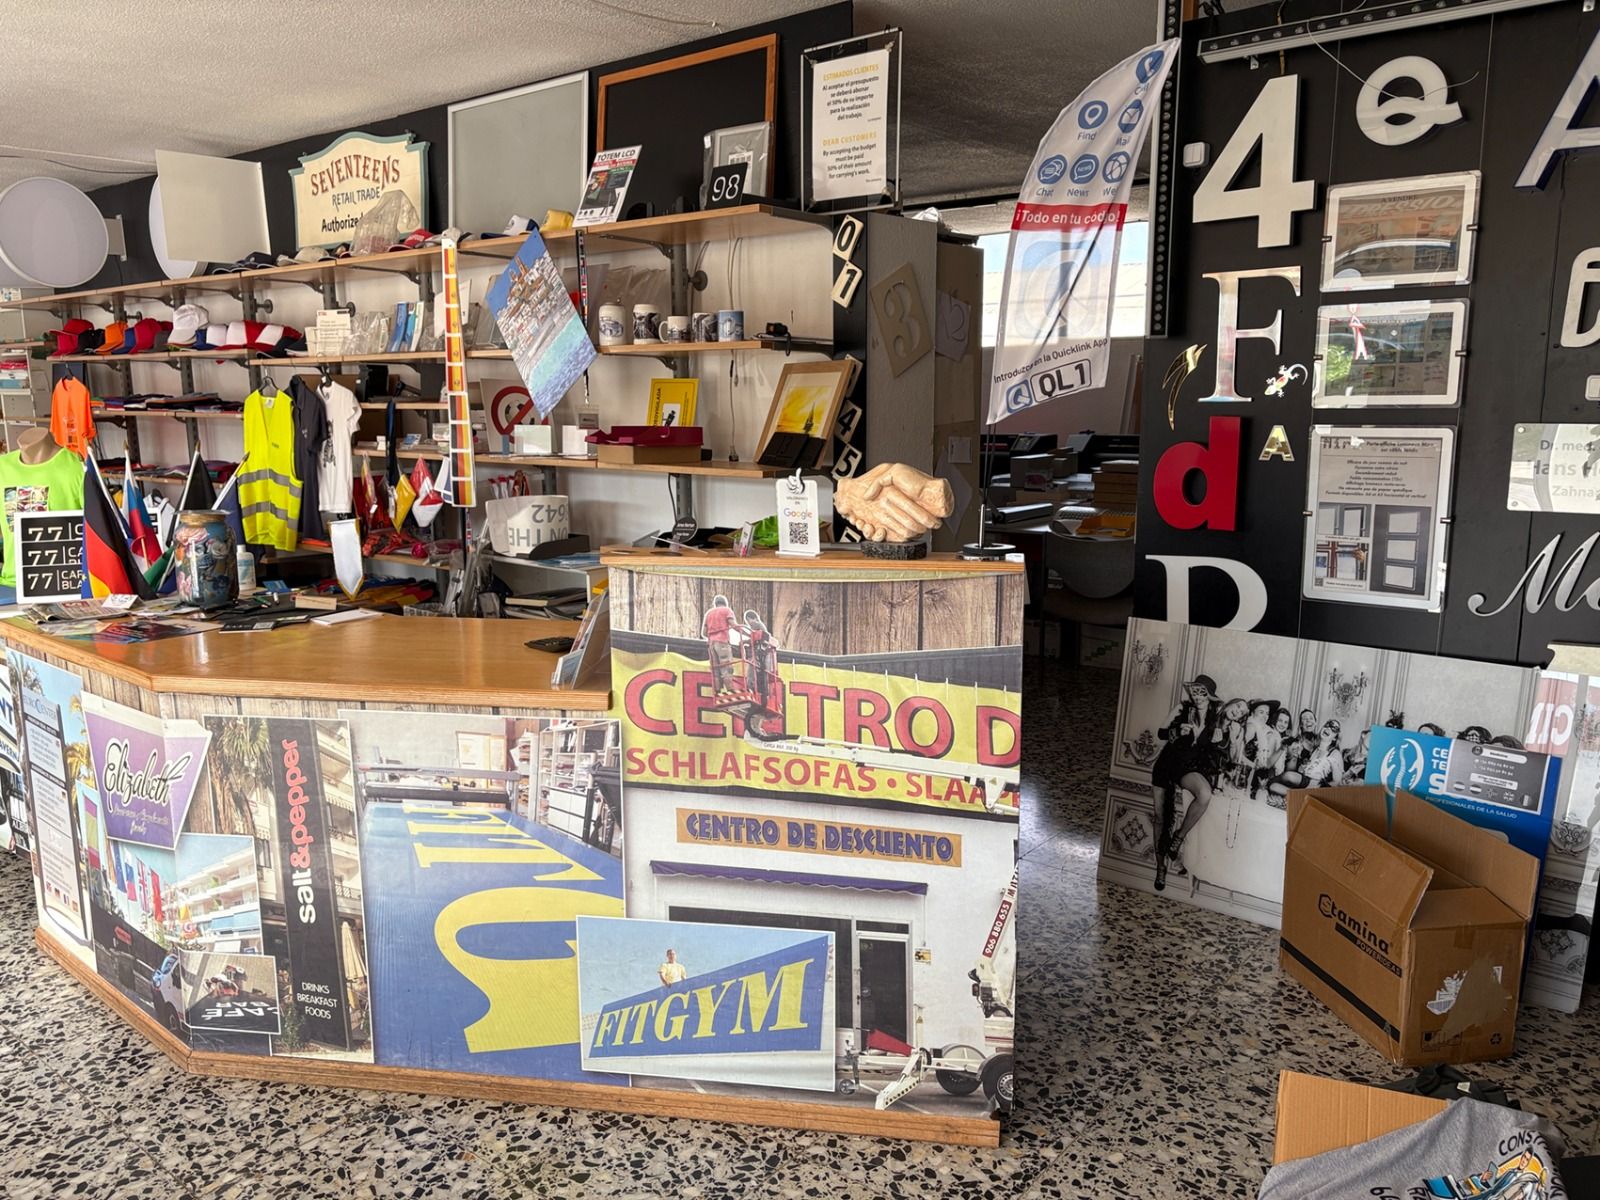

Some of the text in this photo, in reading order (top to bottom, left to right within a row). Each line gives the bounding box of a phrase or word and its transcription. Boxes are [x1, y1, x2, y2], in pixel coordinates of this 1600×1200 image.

[1077, 131, 1097, 141] Find
[597, 149, 636, 161] TOTEM LCD
[1192, 75, 1316, 249] 4
[310, 154, 401, 196] SEVENTEENS
[711, 173, 740, 202] 98
[331, 186, 381, 213] RETAIL TRADE
[1035, 187, 1055, 197] Chat
[1066, 188, 1090, 198] News
[1052, 212, 1067, 225] en
[1070, 211, 1081, 225] tu
[839, 268, 858, 300] 1
[1198, 266, 1302, 402] F
[1043, 353, 1052, 363] la
[1052, 342, 1093, 360] Quicklink
[1092, 338, 1109, 349] App
[837, 407, 858, 437] 4
[1258, 424, 1295, 462] A
[1562, 441, 1596, 452] med.
[834, 448, 859, 478] 5
[1153, 415, 1242, 532] d
[783, 507, 813, 521] Google
[27, 573, 54, 591] 77
[104, 741, 191, 811] Elizabeth
[625, 746, 877, 793] SCHLAFSOFAS
[1495, 808, 1518, 820] SALUD
[686, 812, 954, 863] CENTRO DE DESCUENTO
[984, 938, 996, 954] 966
[991, 921, 1003, 937] 880
[998, 903, 1010, 920] 655
[1318, 893, 1390, 956] Stamina
[296, 992, 338, 1008] BREAKFAST
[301, 981, 330, 994] DRINKS
[304, 1005, 332, 1020] FOODS
[593, 958, 815, 1048] FITGYM
